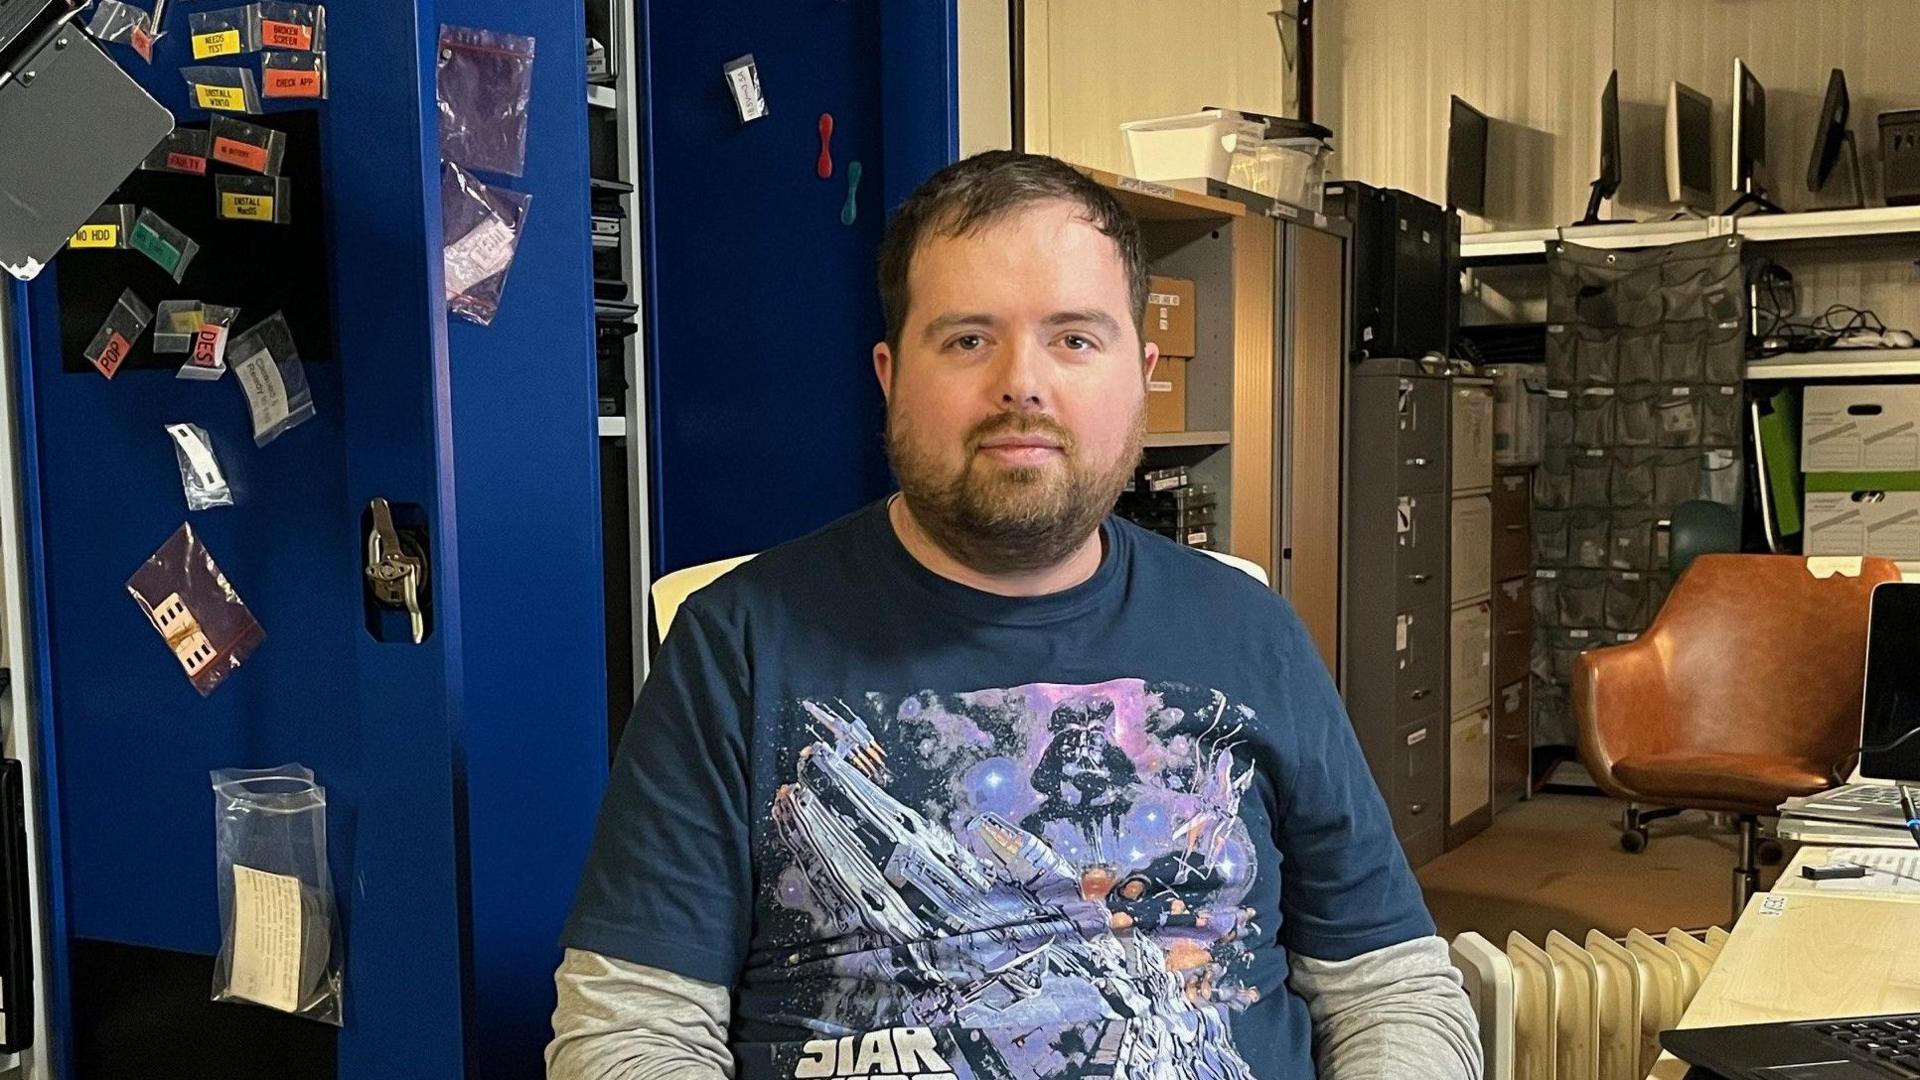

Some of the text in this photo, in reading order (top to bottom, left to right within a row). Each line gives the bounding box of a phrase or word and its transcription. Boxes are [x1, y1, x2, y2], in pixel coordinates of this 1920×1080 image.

[205, 34, 225, 44] NEEDS
[273, 34, 298, 46] SCREEN
[208, 44, 223, 54] TEST
[275, 77, 314, 88] CHECK APP
[205, 88, 232, 99] INSTALL
[170, 155, 200, 169] FAULTY
[234, 197, 261, 207] INSTALL
[76, 229, 110, 241] NO HDD
[197, 331, 216, 363] DES
[100, 340, 120, 372] POP
